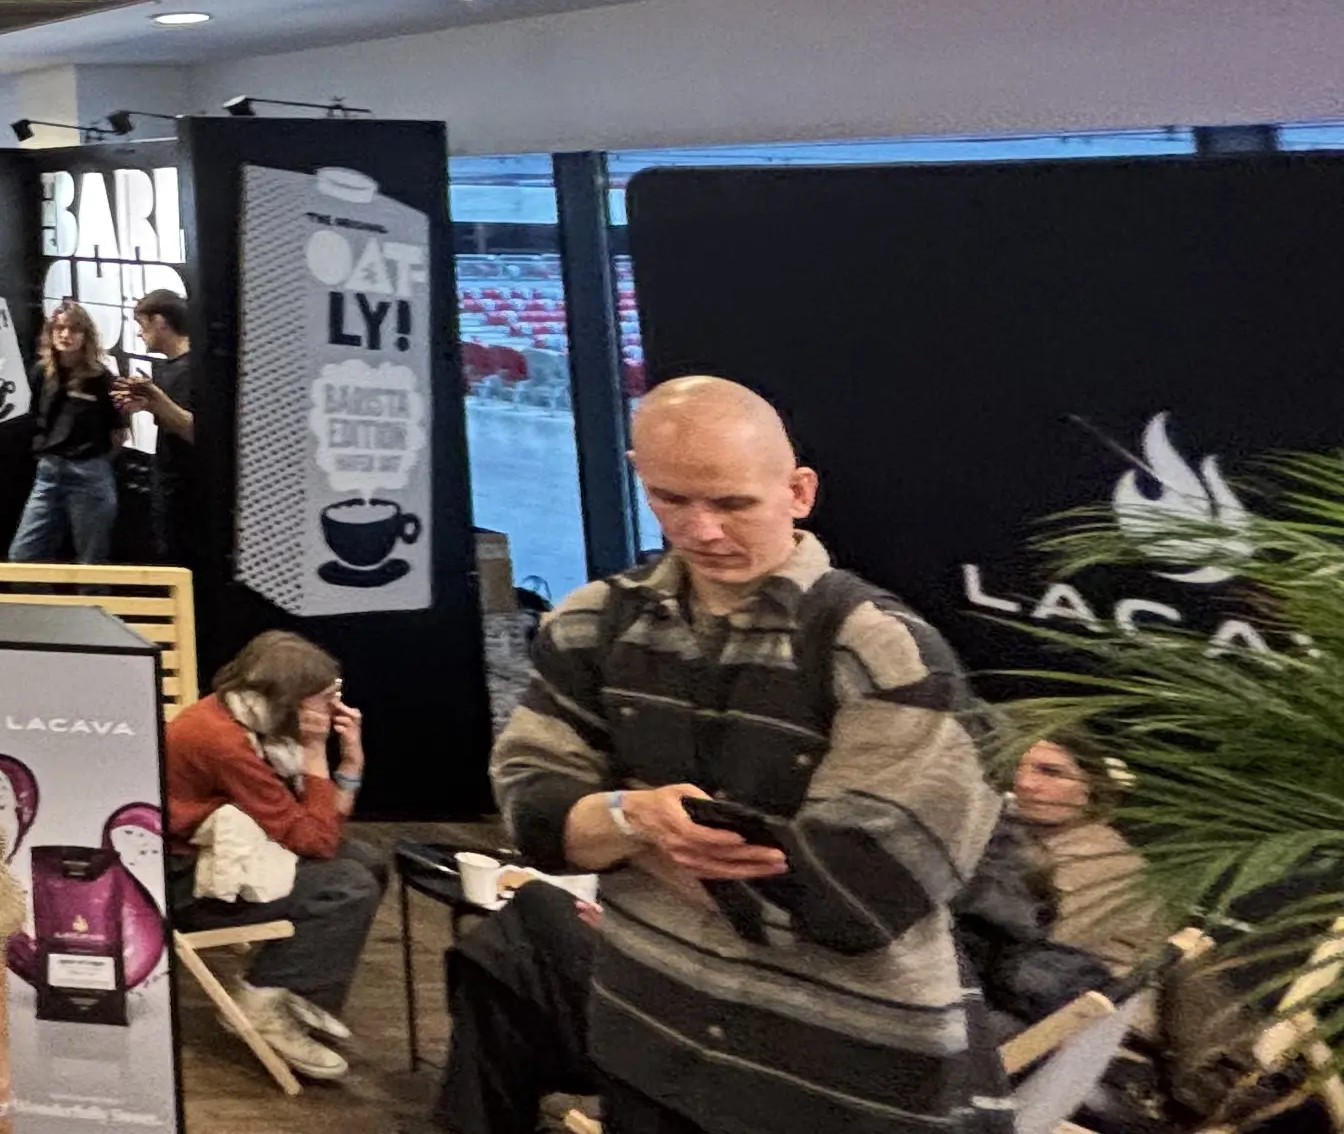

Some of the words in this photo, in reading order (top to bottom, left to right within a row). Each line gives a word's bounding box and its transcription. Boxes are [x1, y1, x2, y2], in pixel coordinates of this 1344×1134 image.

[328, 291, 411, 352] LY!
[324, 383, 410, 419] BARISTA
[328, 419, 409, 450] EDITION
[5, 716, 137, 737] LACAVA
